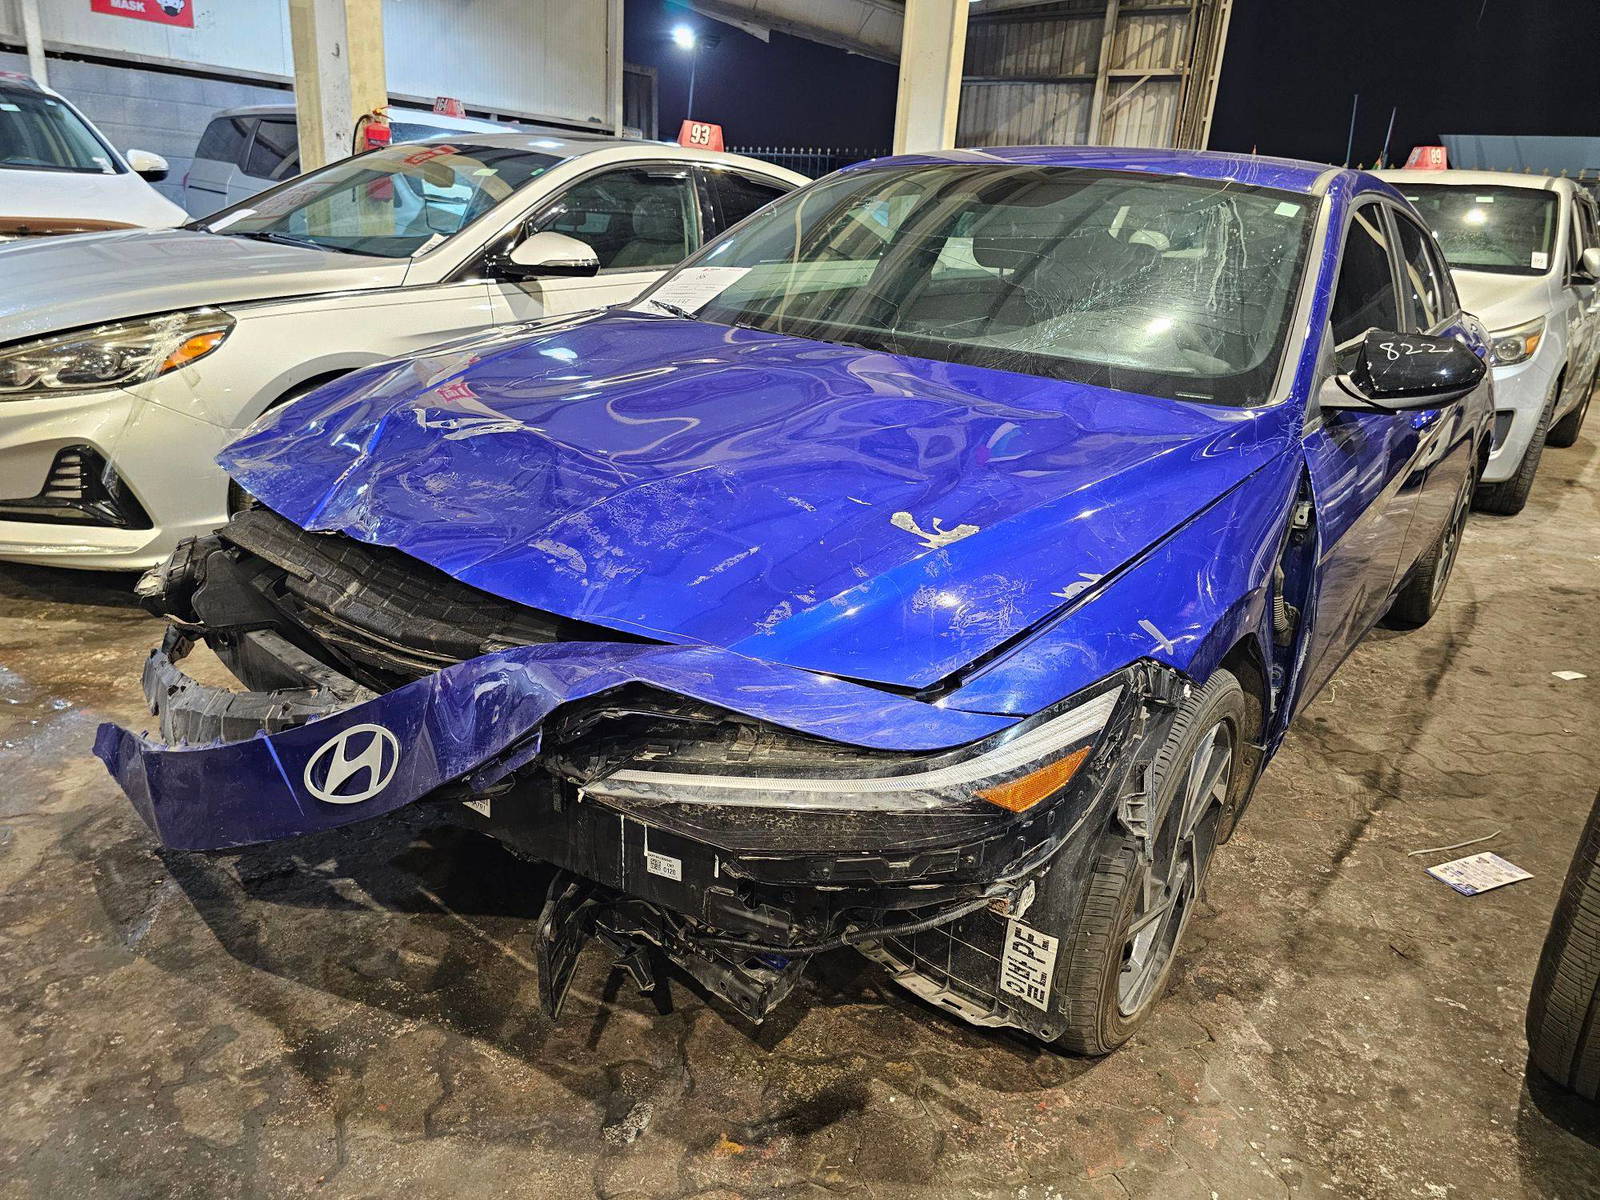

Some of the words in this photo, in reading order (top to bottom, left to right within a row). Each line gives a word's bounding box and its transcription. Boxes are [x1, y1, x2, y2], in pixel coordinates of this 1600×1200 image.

[111, 0, 146, 13] MASK
[690, 124, 711, 145] 93
[1379, 342, 1454, 360] 822
[1012, 927, 1049, 964] PE
